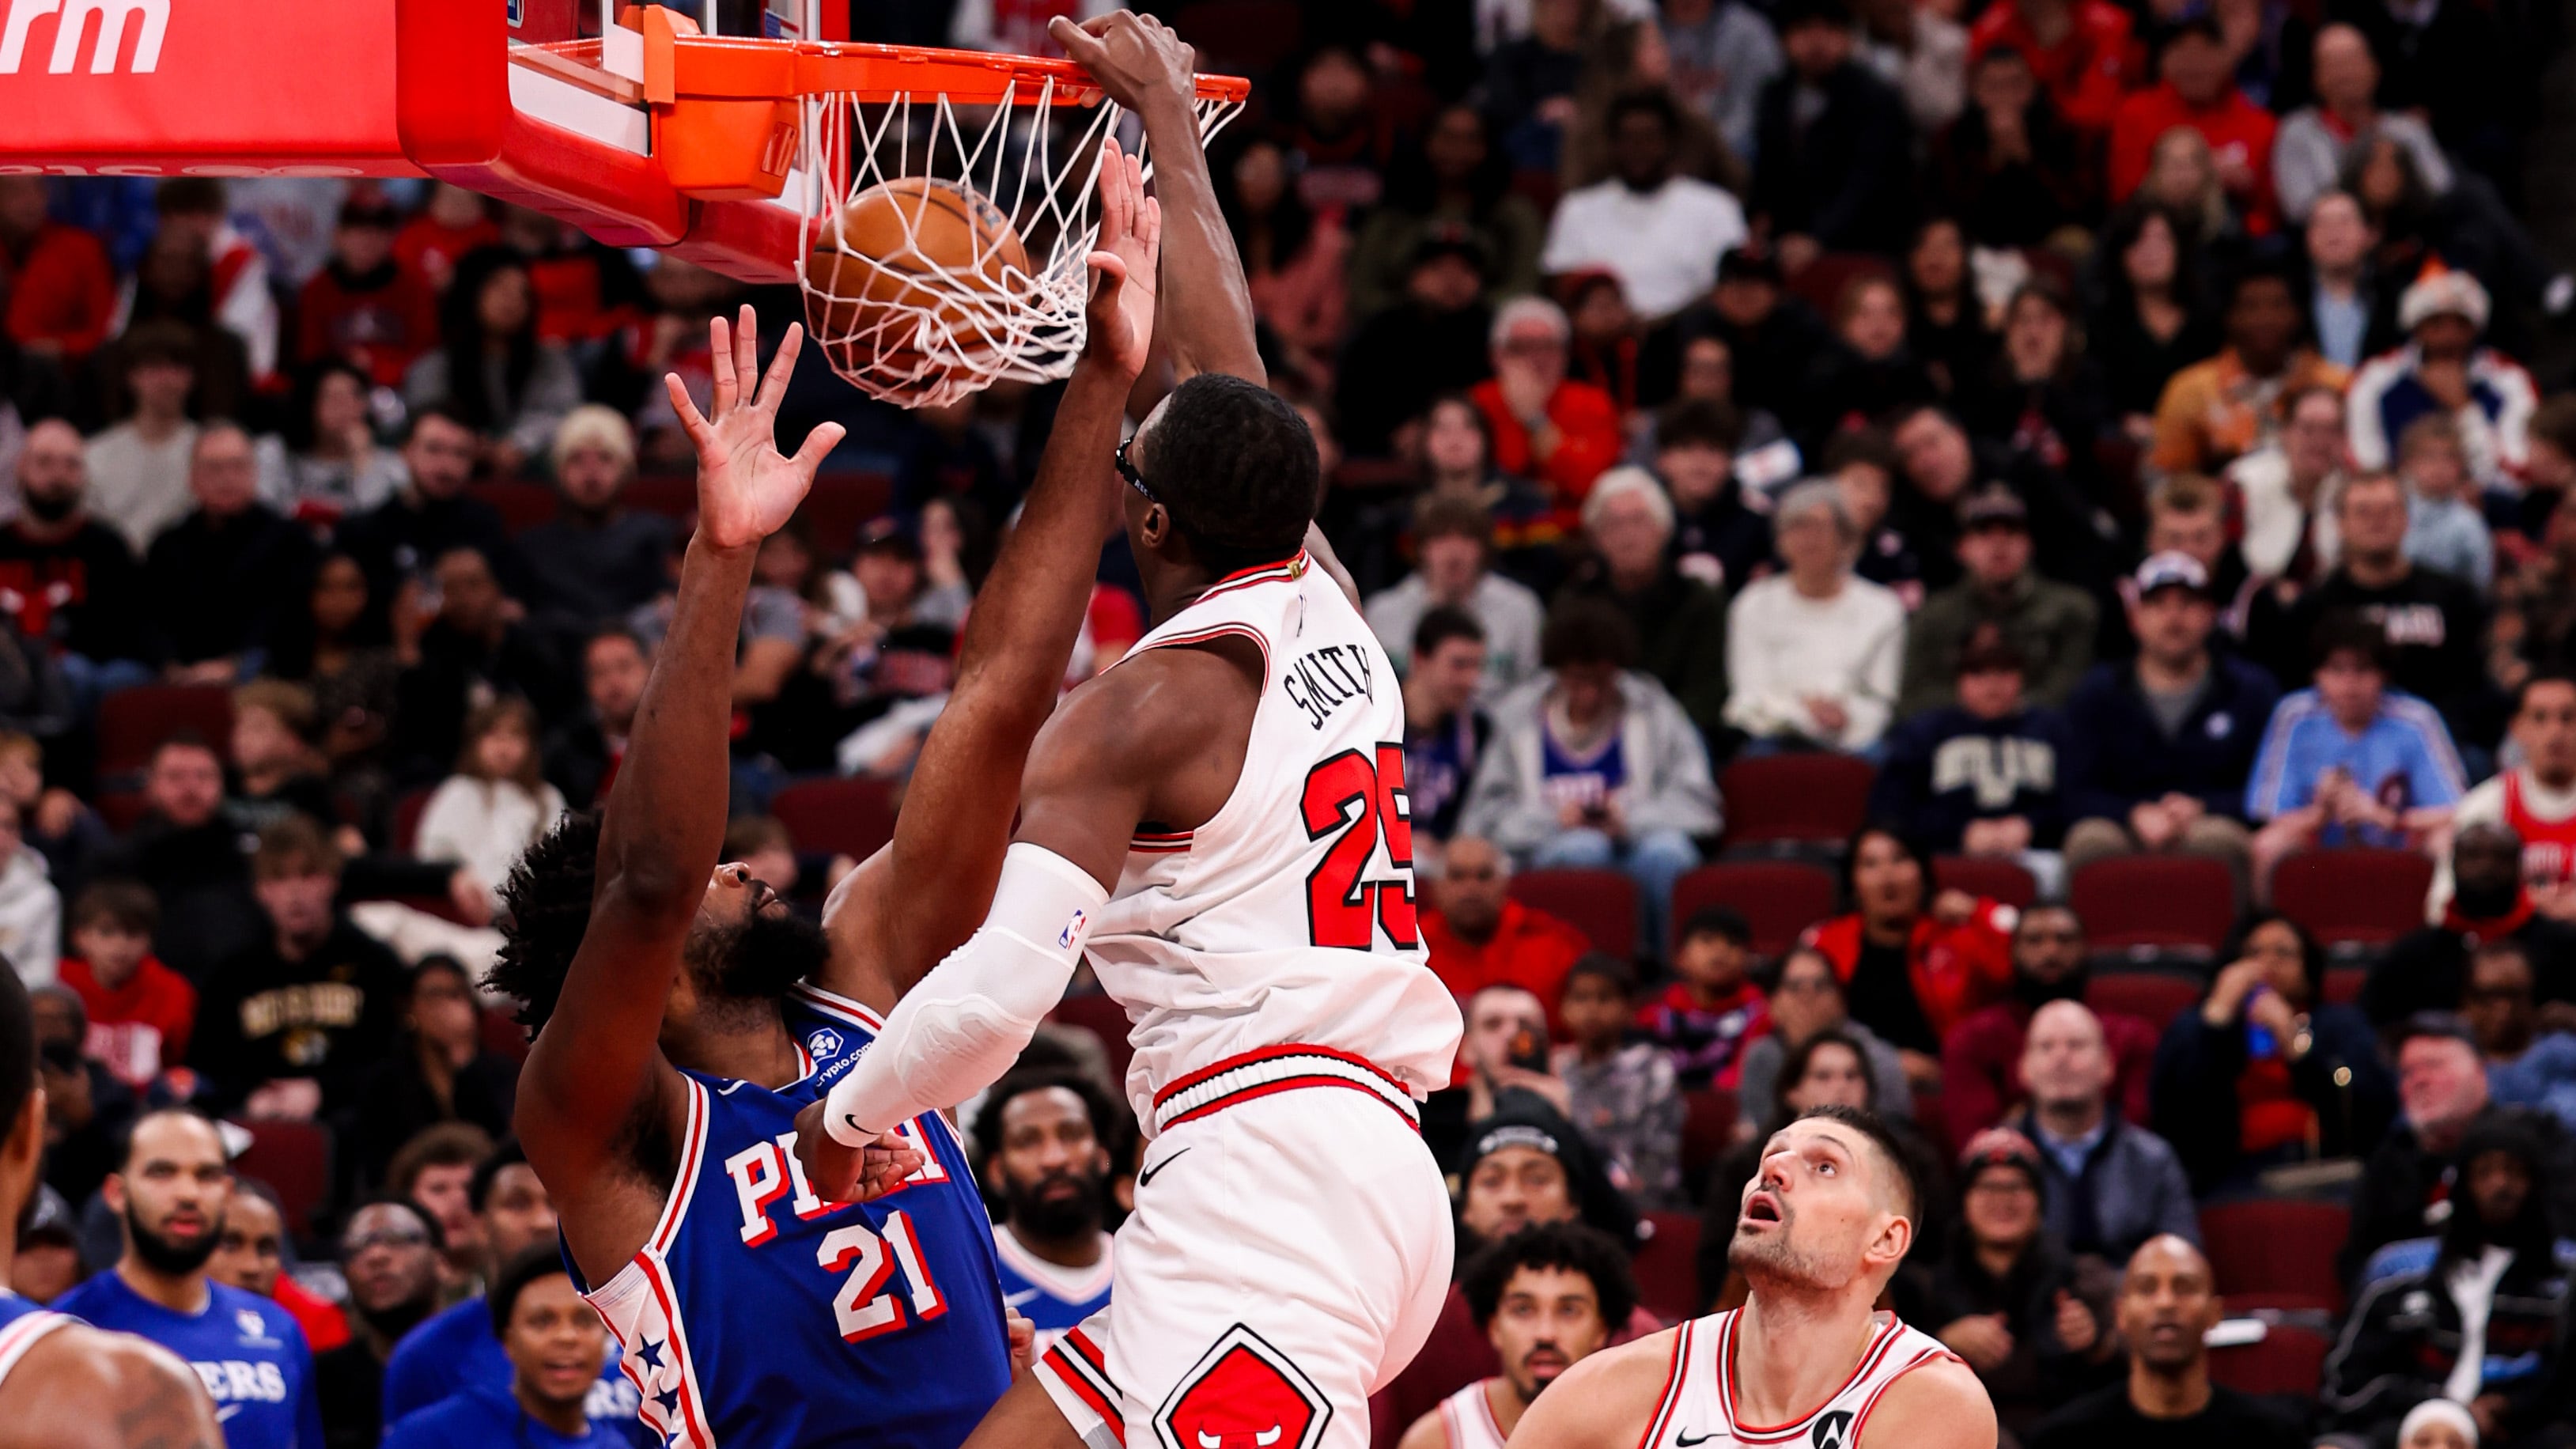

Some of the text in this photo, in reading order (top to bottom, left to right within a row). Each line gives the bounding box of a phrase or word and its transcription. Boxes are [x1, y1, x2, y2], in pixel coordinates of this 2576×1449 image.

[1284, 644, 1374, 730] SMITH
[1299, 741, 1419, 951] 25
[816, 1209, 948, 1344] 21
